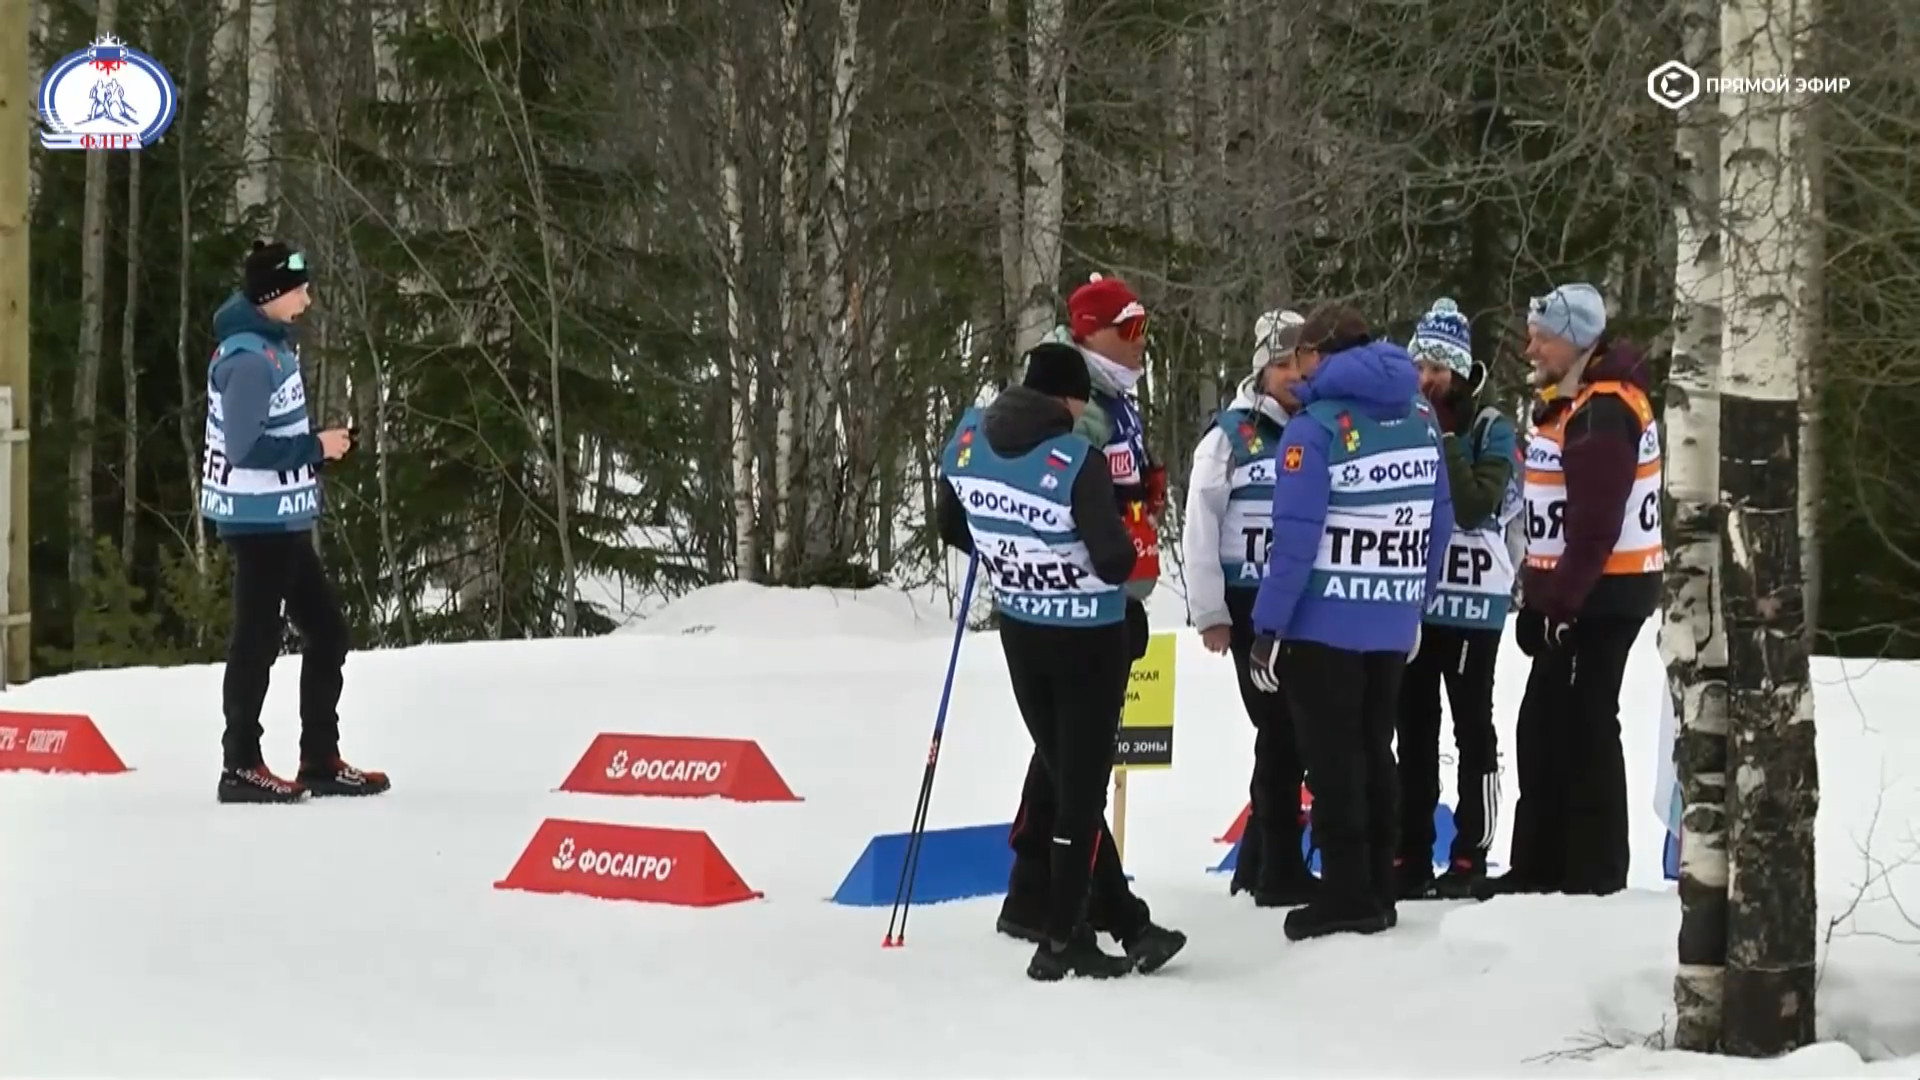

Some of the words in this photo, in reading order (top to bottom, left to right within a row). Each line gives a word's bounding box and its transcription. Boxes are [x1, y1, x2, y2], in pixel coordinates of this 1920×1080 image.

[969, 489, 1059, 526] ФОСАГРО
[1395, 506, 1413, 526] 22
[999, 540, 1019, 558] 24
[1133, 741, 1168, 753] ЗОНЫ
[630, 757, 721, 782] ФОСАГРО
[577, 847, 672, 881] ФОСАГРО
